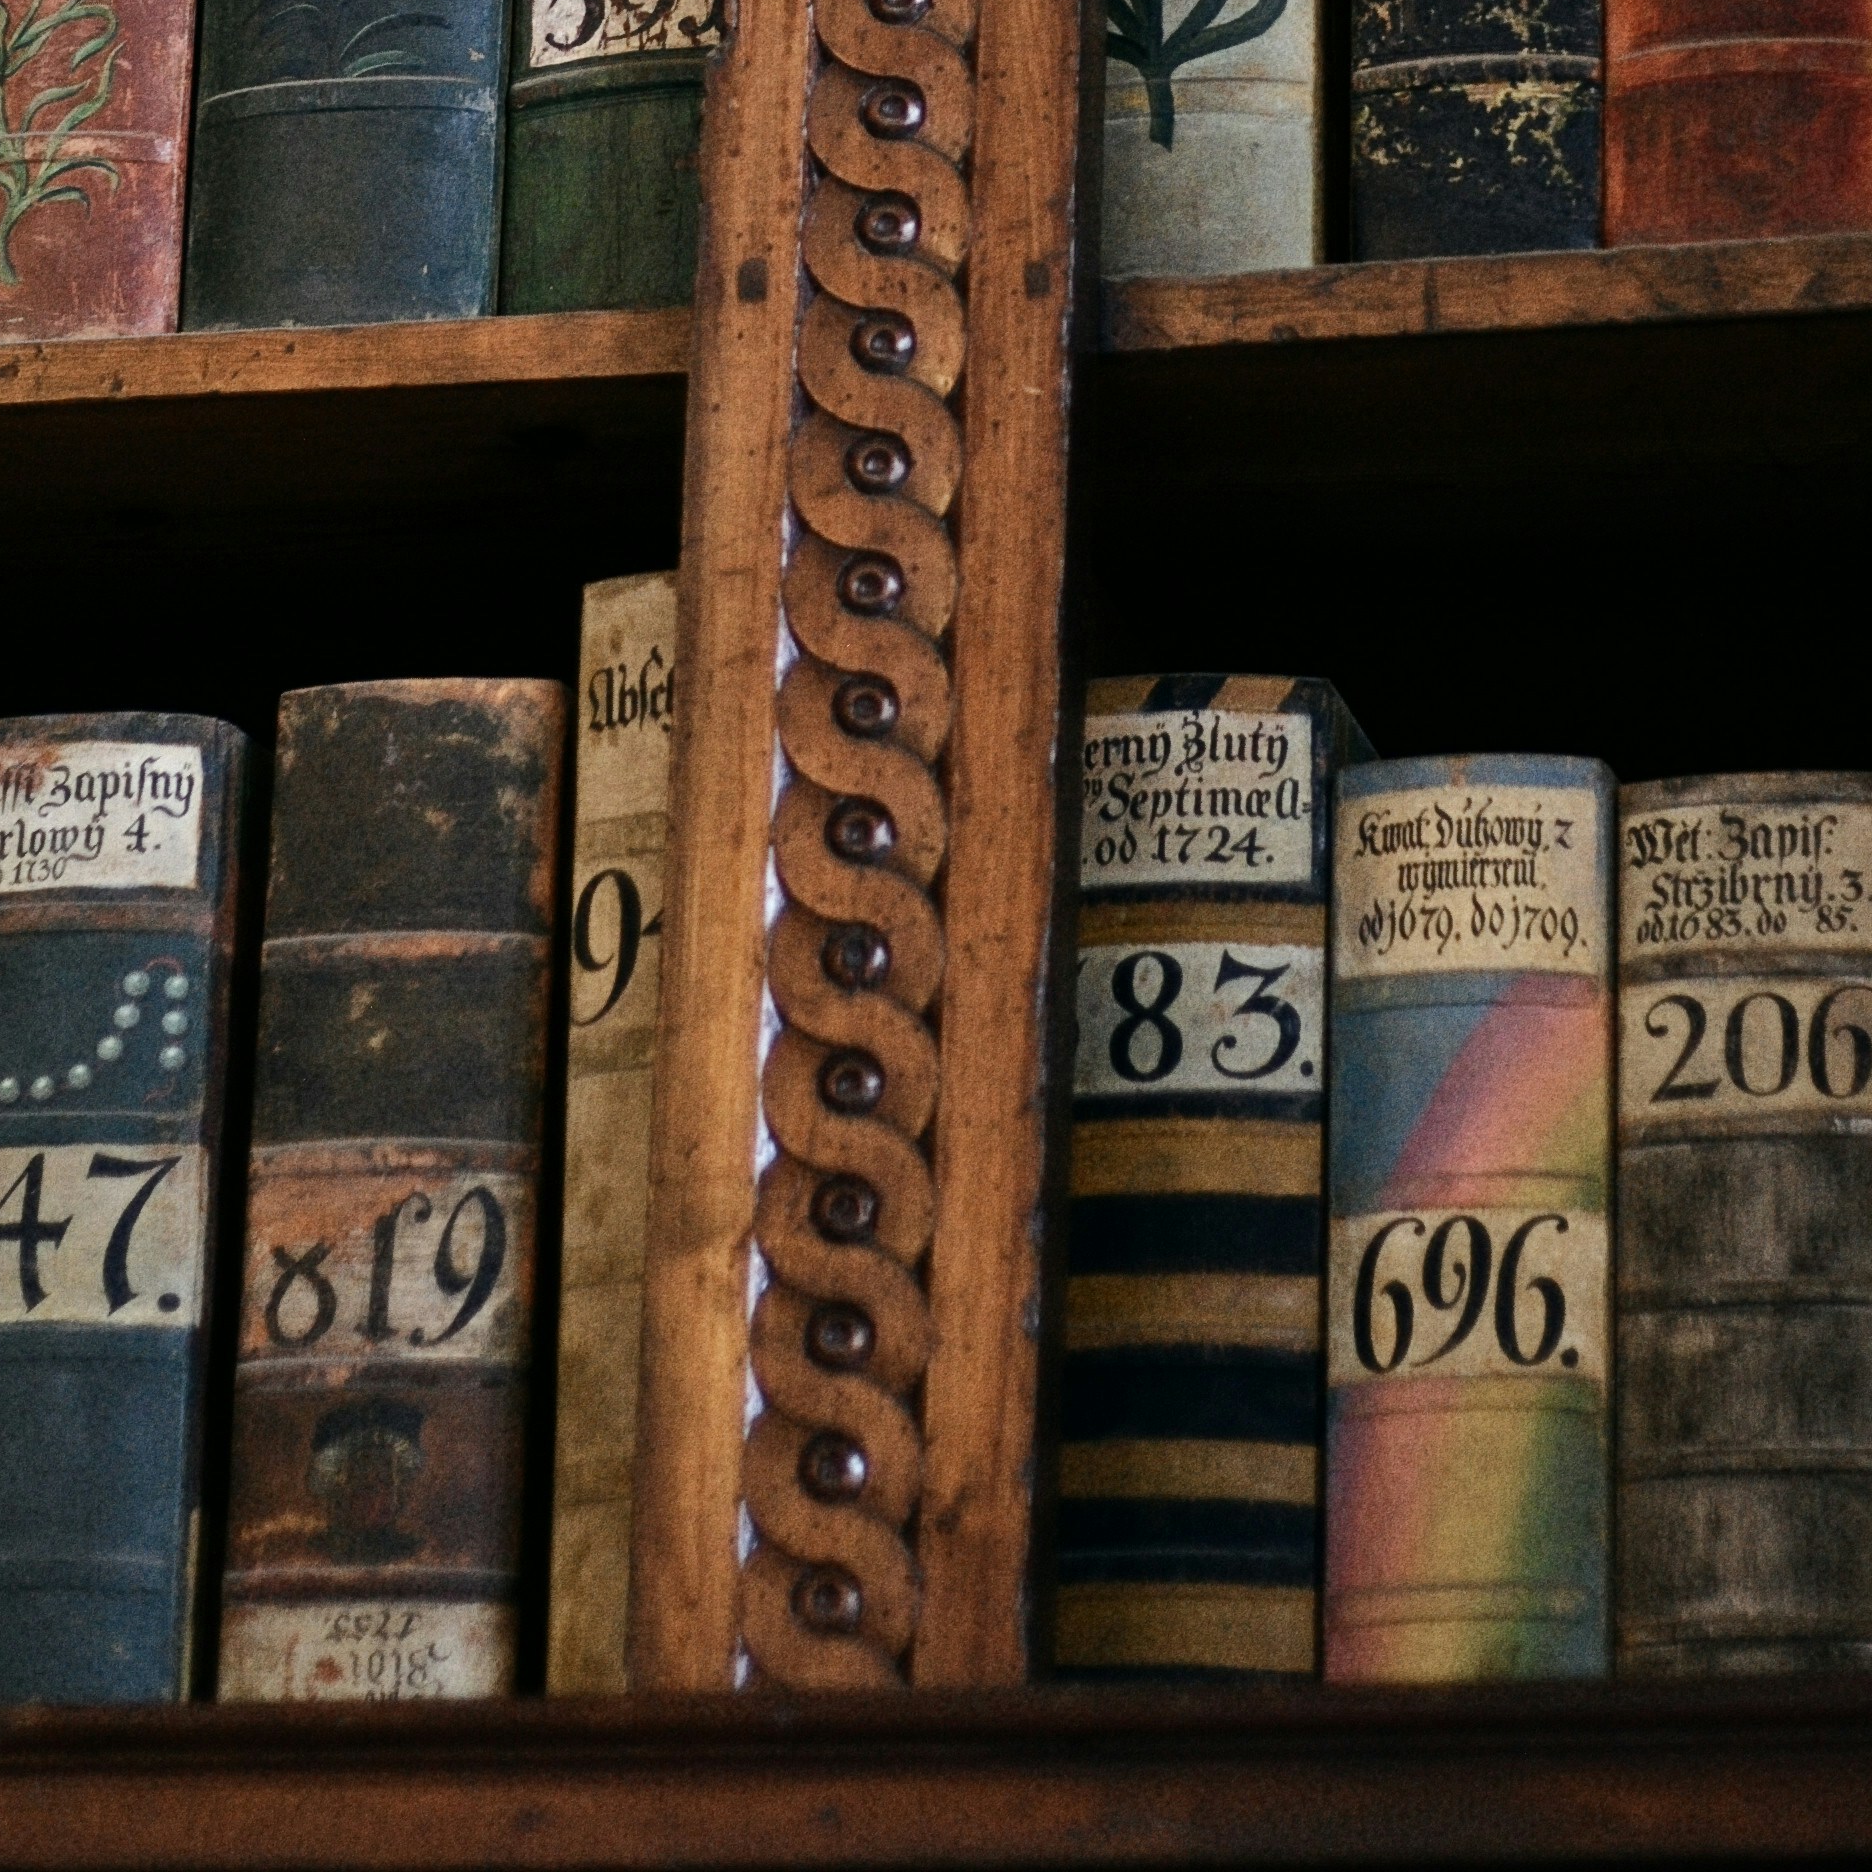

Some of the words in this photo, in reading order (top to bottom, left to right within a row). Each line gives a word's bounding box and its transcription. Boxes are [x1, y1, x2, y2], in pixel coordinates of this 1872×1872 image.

[121, 811, 162, 855] 4.
[1152, 823, 1275, 867] 1724.
[1078, 949, 1315, 1084] 83.
[1353, 1214, 1579, 1373] 696.
